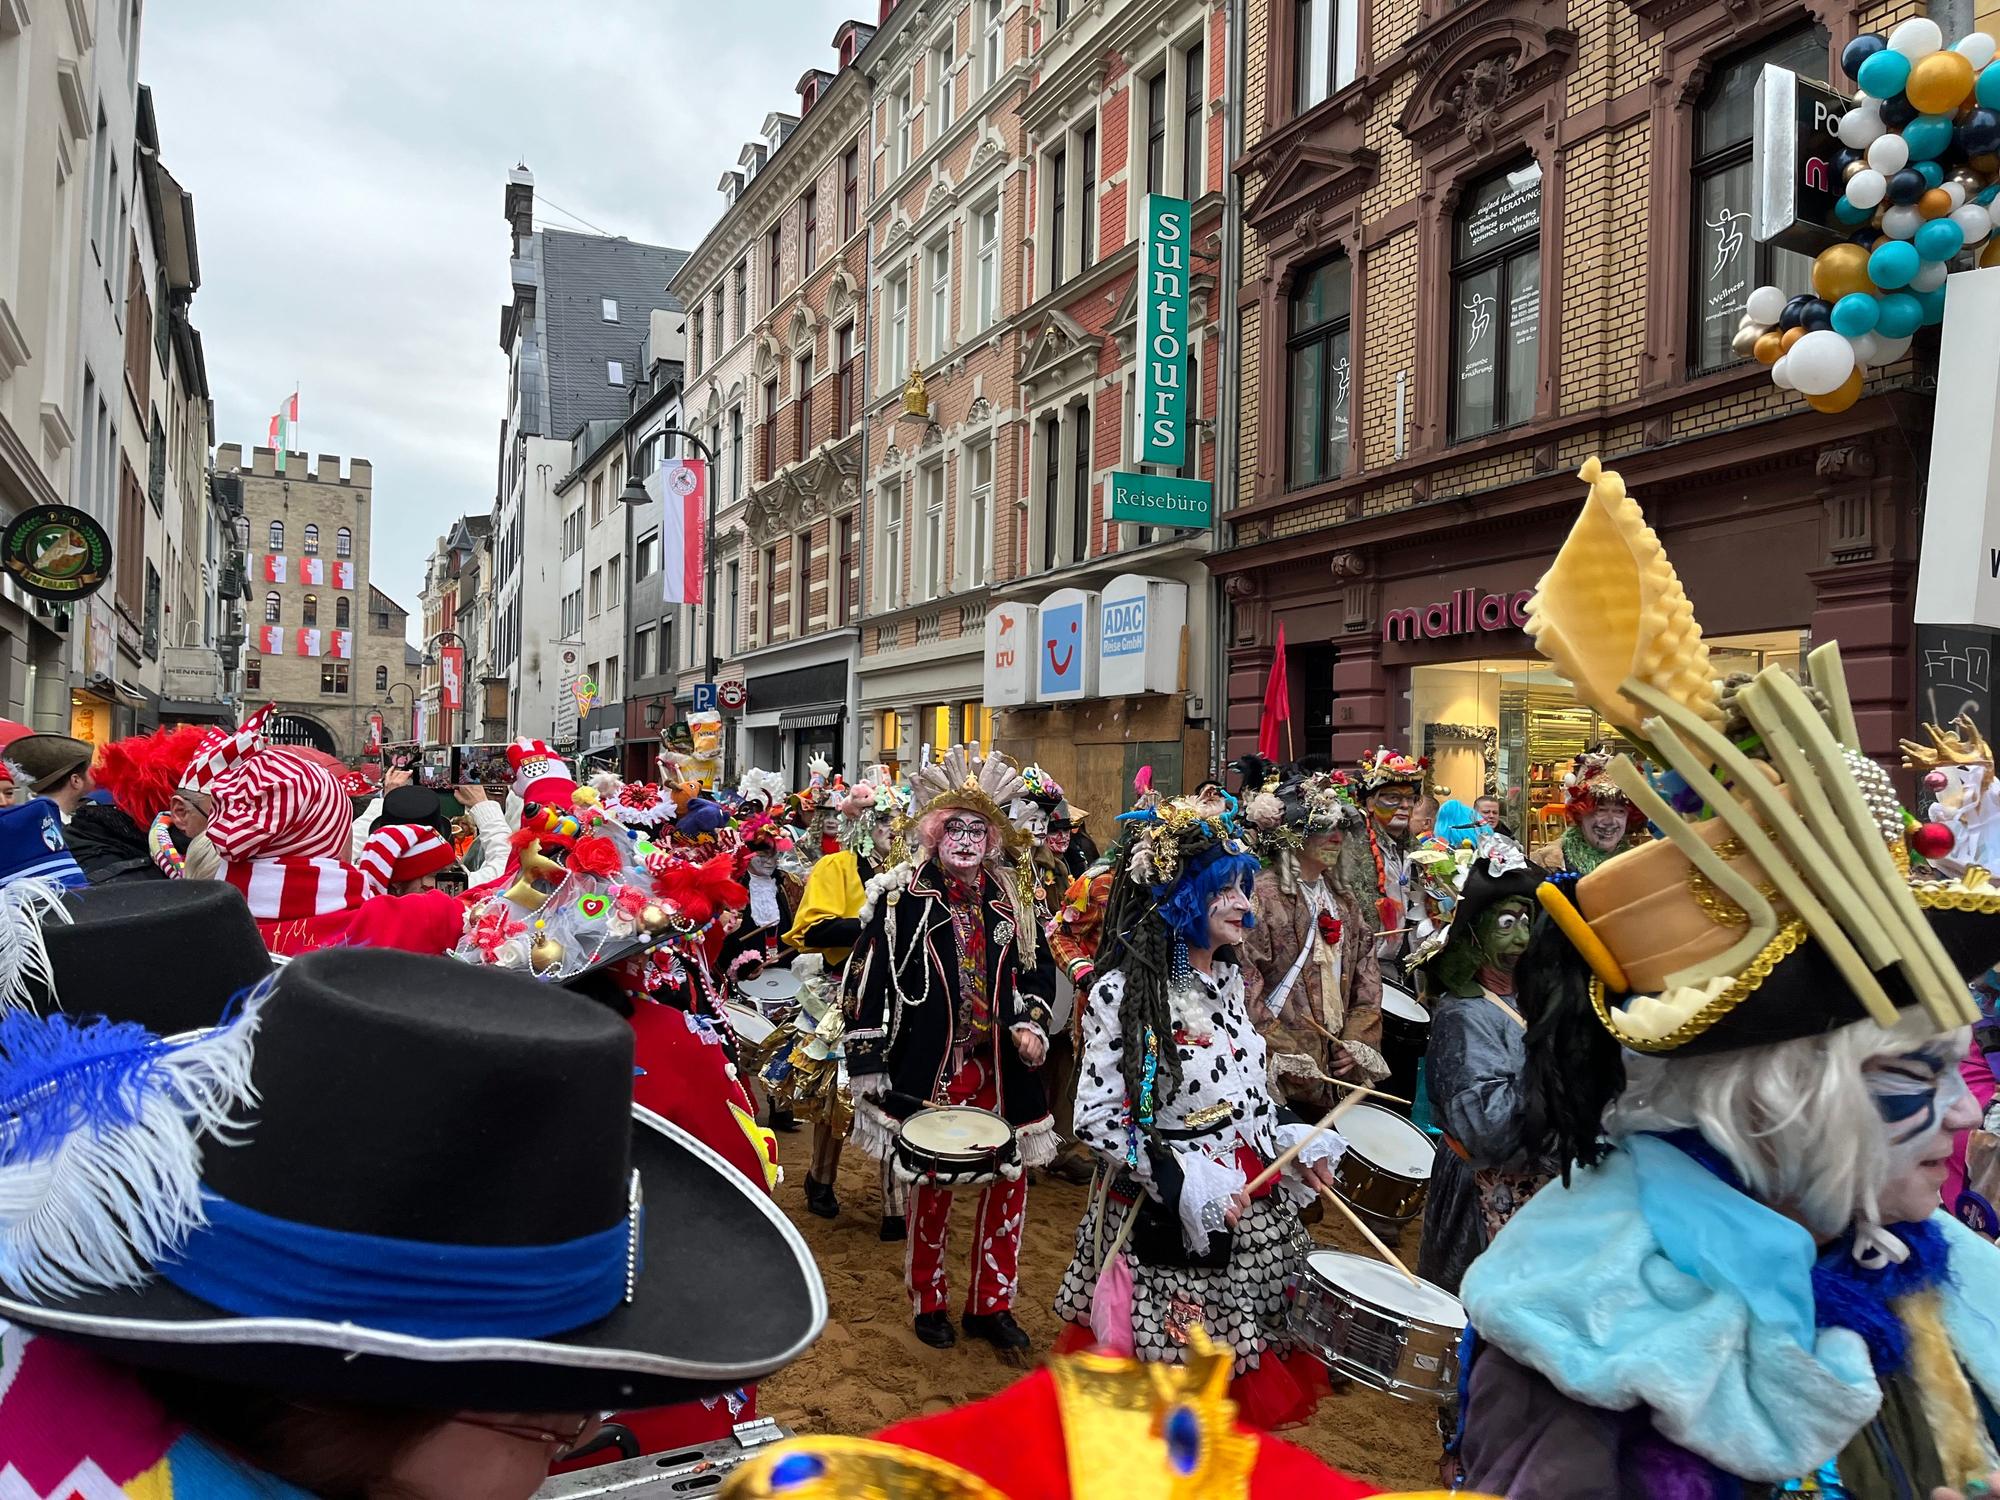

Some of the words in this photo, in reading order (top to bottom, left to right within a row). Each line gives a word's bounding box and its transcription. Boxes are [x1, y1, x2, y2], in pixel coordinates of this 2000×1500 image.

[1469, 220, 1498, 238] Wellness
[1499, 208, 1537, 232] Ernährung
[1708, 280, 1745, 306] Wellness
[1151, 213, 1183, 448] suntours
[1461, 365, 1493, 380] Ernährung
[1115, 487, 1208, 513] Reisebüro
[1104, 603, 1143, 636] ADAC
[1103, 637, 1121, 653] Reise
[1122, 633, 1143, 651] GmbH
[995, 650, 1015, 668] LTU
[697, 687, 710, 710] P
